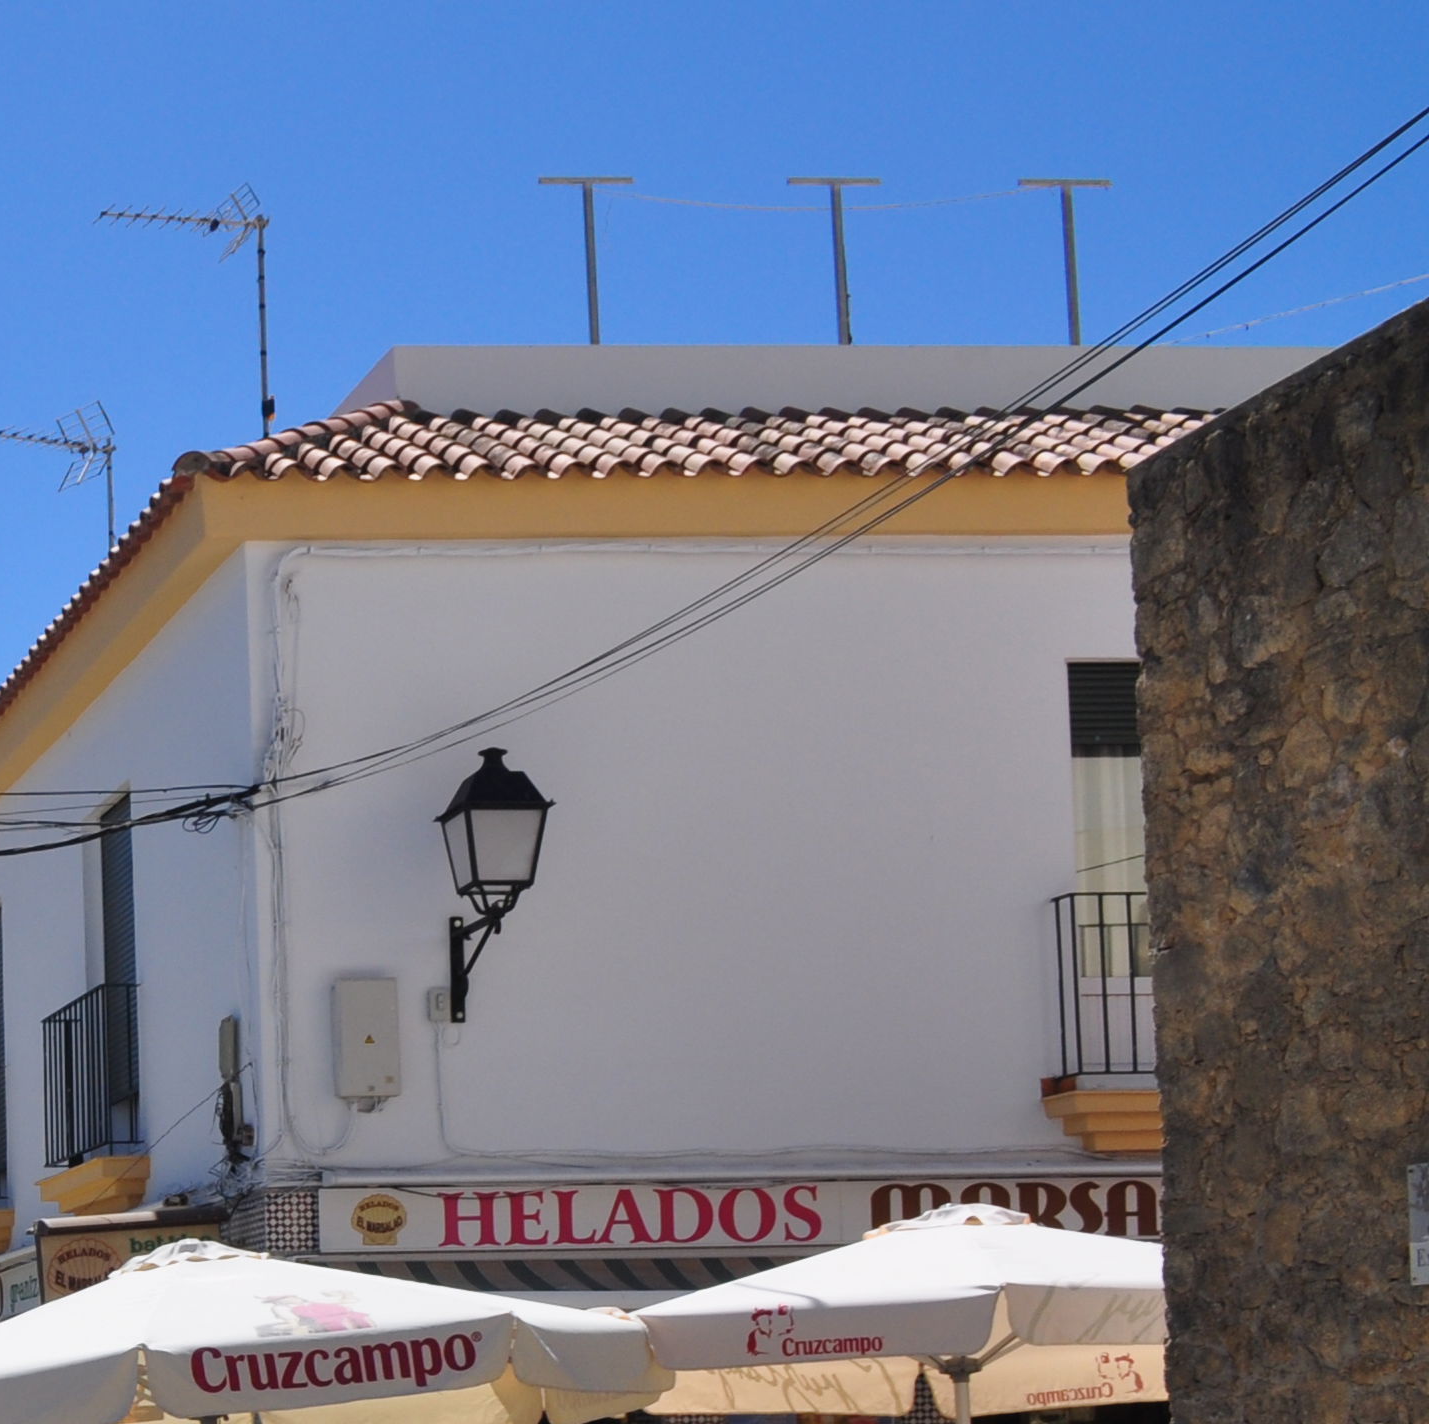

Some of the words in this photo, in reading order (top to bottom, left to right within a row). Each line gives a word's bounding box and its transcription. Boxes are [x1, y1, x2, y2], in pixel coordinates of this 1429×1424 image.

[438, 1184, 822, 1247] HELADOS
[57, 1247, 111, 1265] HELADOS
[55, 1271, 67, 1288] EL
[782, 1335, 883, 1358] Cruzcampo
[190, 1332, 477, 1393] Cruzcampo
